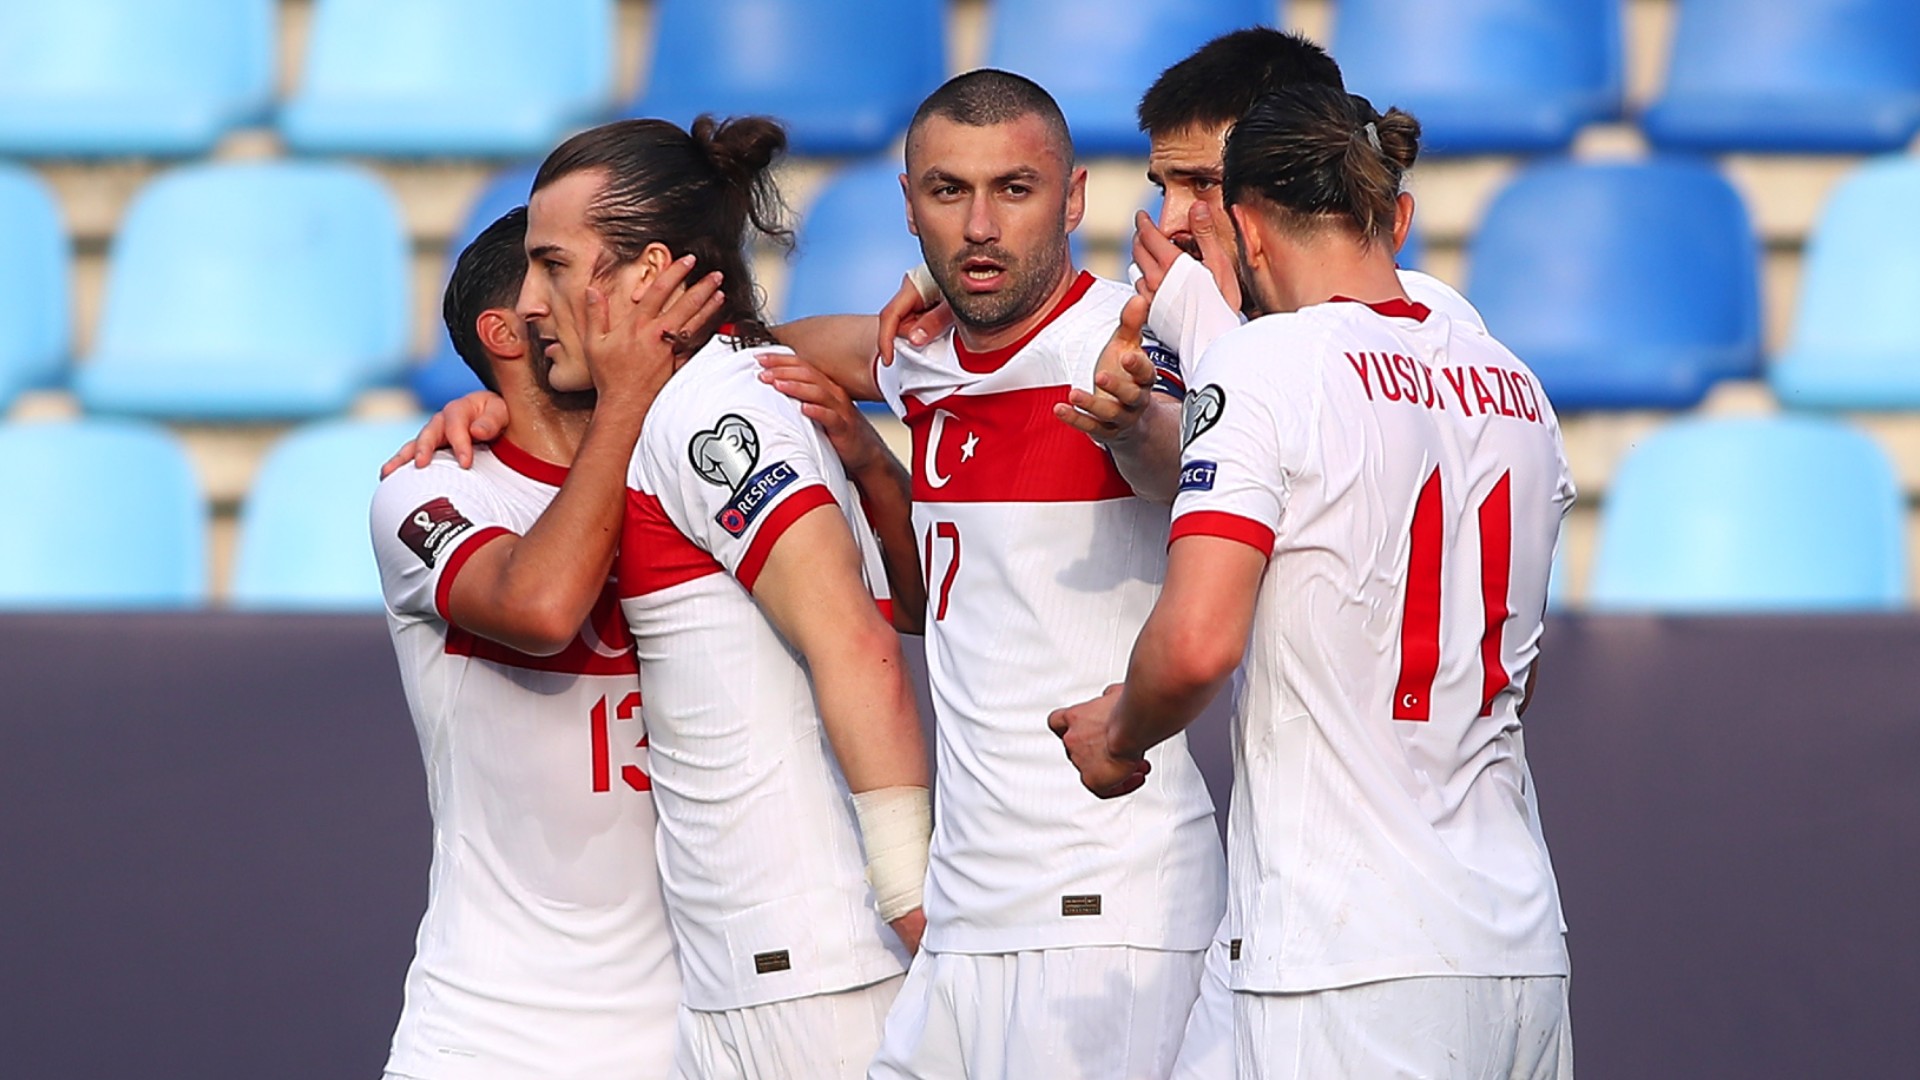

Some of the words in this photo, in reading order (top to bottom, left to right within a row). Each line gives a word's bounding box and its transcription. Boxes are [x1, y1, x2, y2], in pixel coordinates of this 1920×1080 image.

[1441, 365, 1543, 424] YAZICI
[737, 462, 792, 515] RESPECT
[1392, 462, 1512, 721] 11
[590, 691, 652, 793] 13
